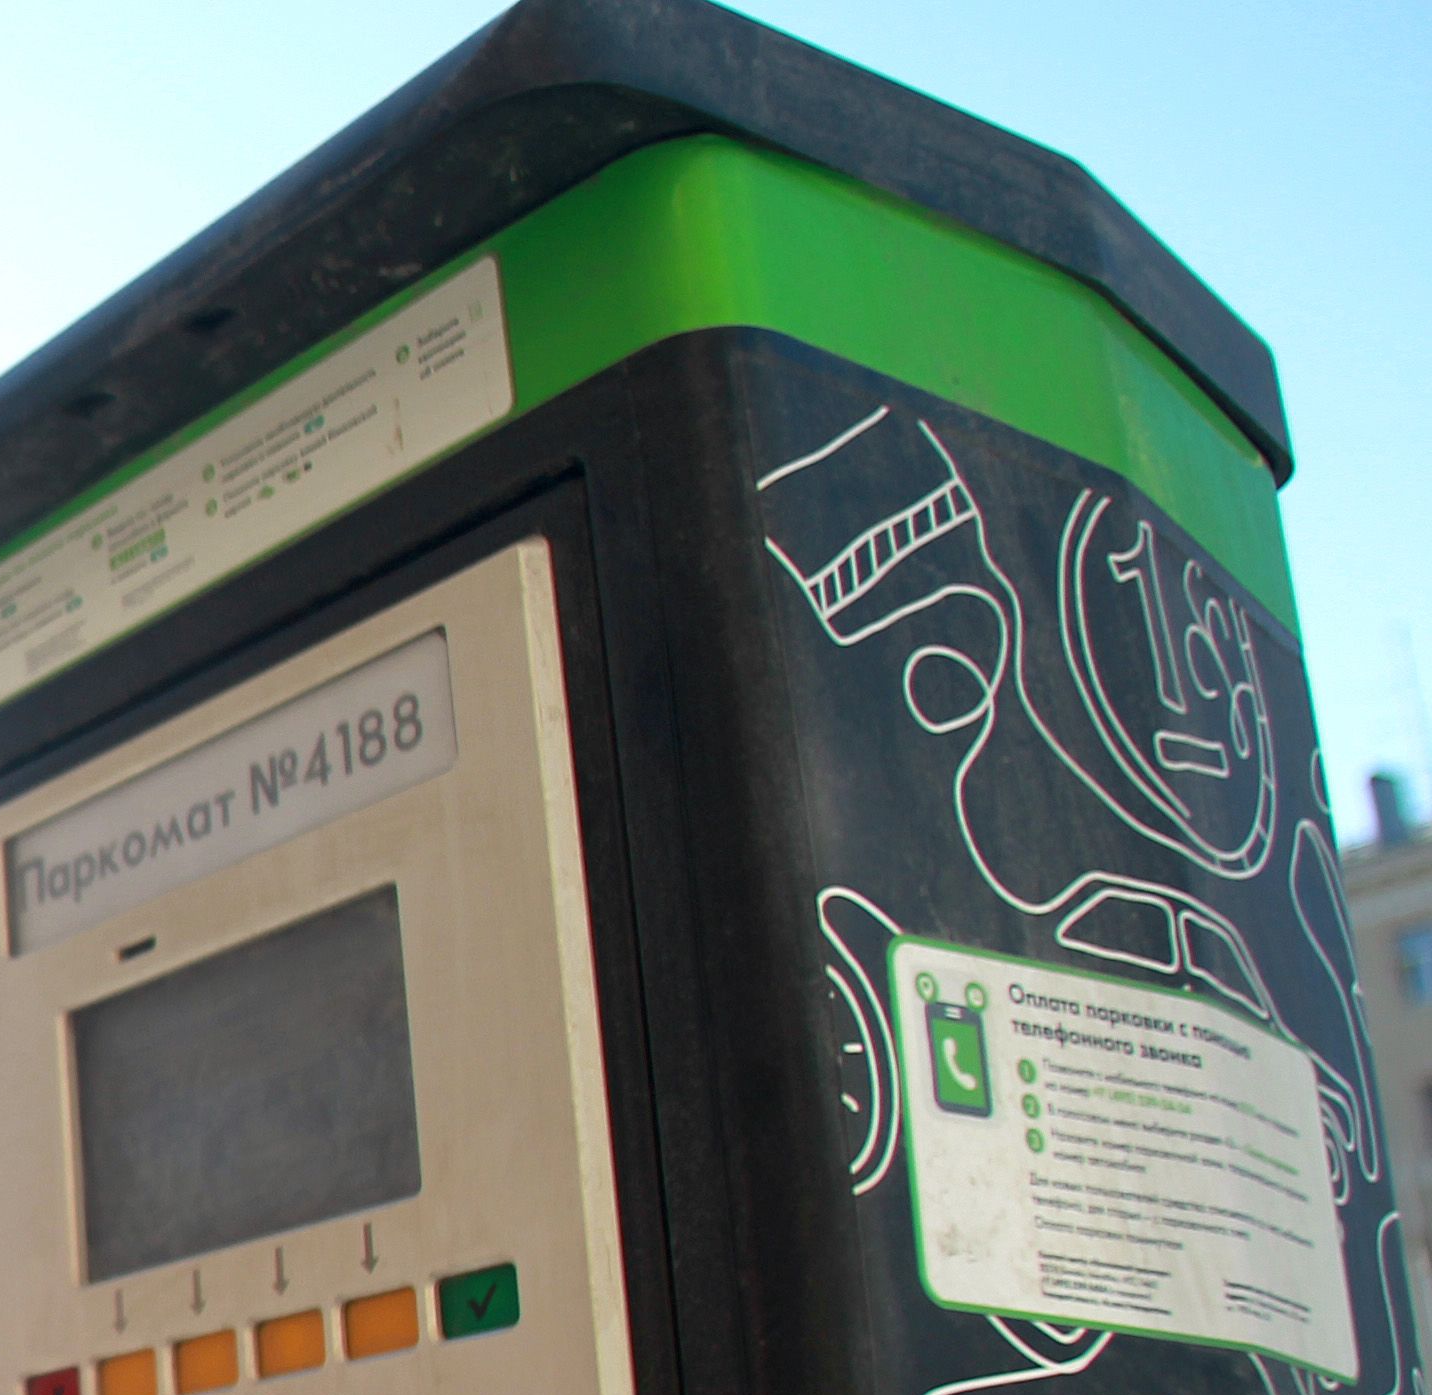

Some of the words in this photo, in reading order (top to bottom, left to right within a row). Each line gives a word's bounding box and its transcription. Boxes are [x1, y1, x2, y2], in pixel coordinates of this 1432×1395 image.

[16, 789, 235, 914] Паркомат
[250, 693, 423, 815] №4188
[1008, 983, 1081, 1016] Оплата
[1086, 1004, 1174, 1033] парковки
[1179, 1022, 1189, 1037] с
[1011, 1019, 1135, 1056] телефонного
[1140, 1043, 1203, 1069] звонка
